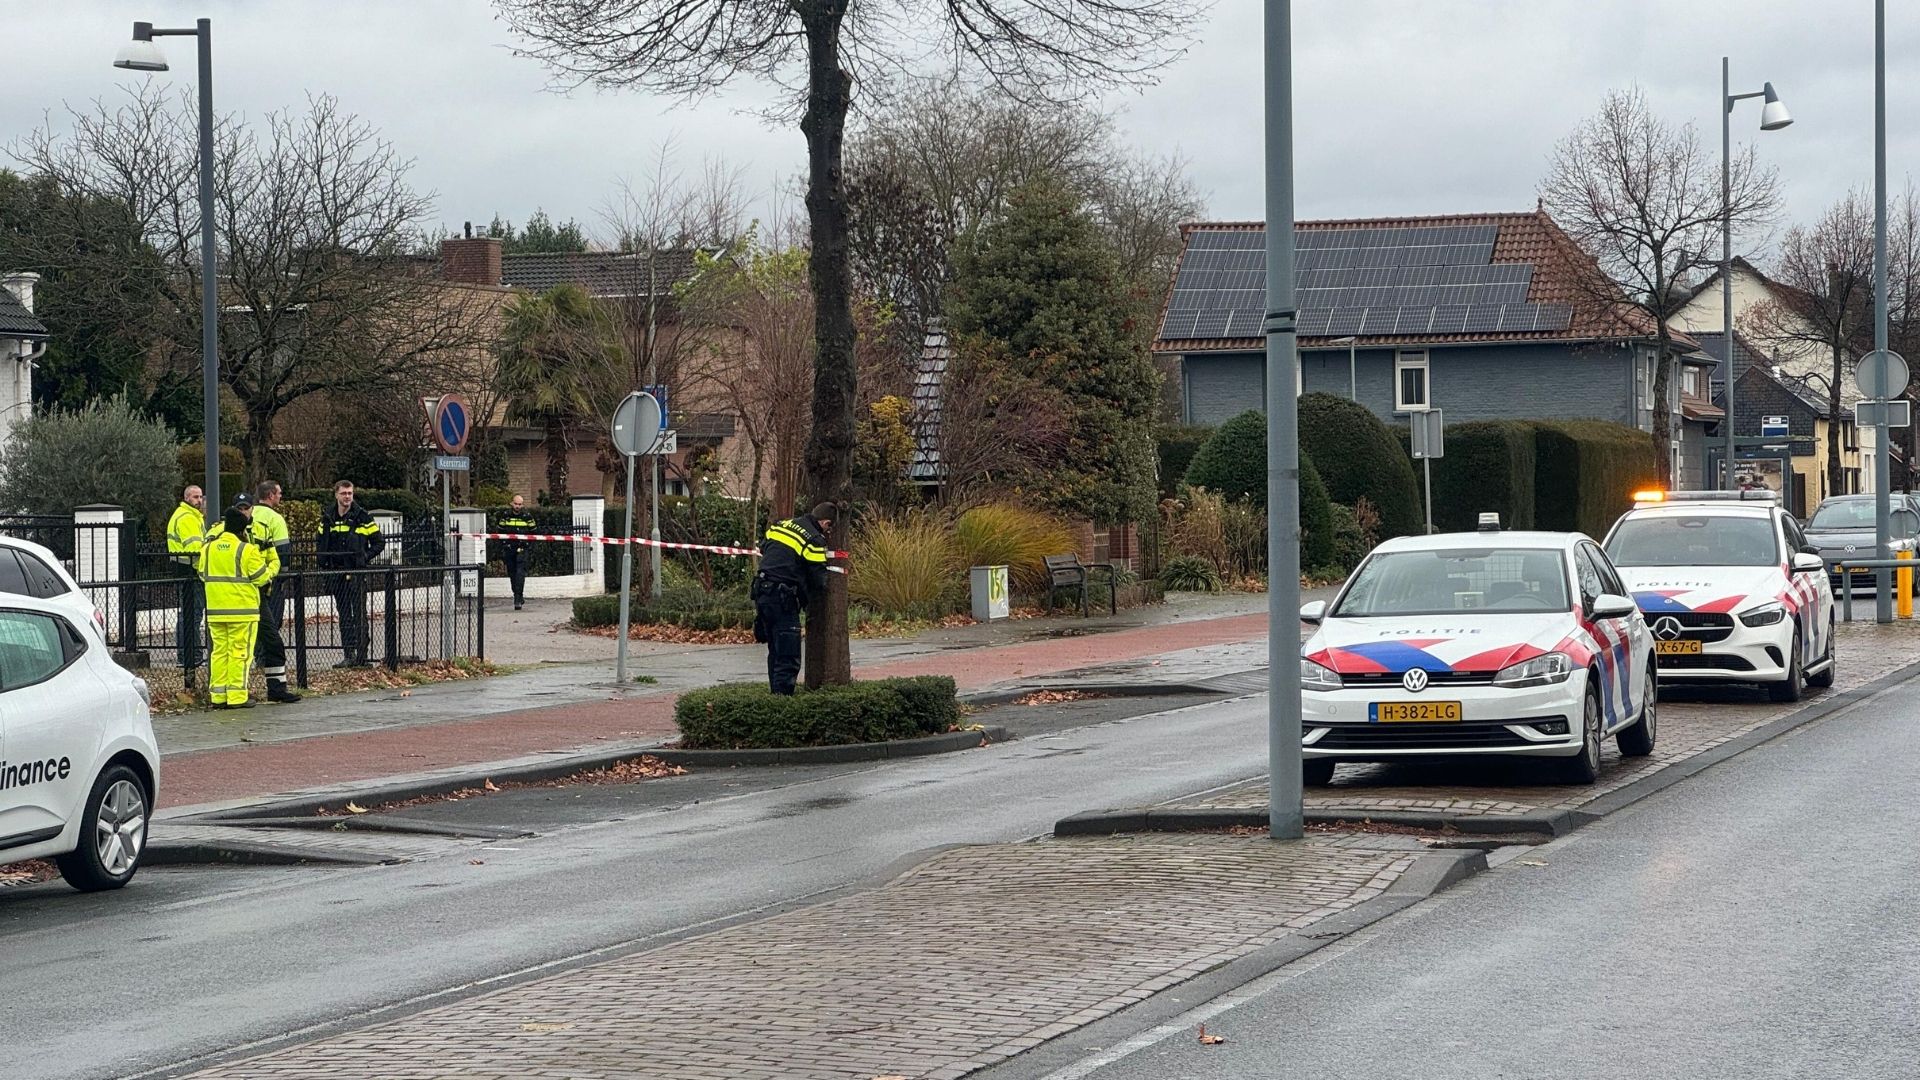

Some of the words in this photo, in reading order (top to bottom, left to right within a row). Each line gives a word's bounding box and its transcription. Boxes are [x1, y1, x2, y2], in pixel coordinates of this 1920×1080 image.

[1379, 628, 1482, 637] POLITIE
[1656, 641, 1698, 654] X-67-G
[1384, 704, 1455, 720] H-382-LG
[0, 756, 71, 790] inance
